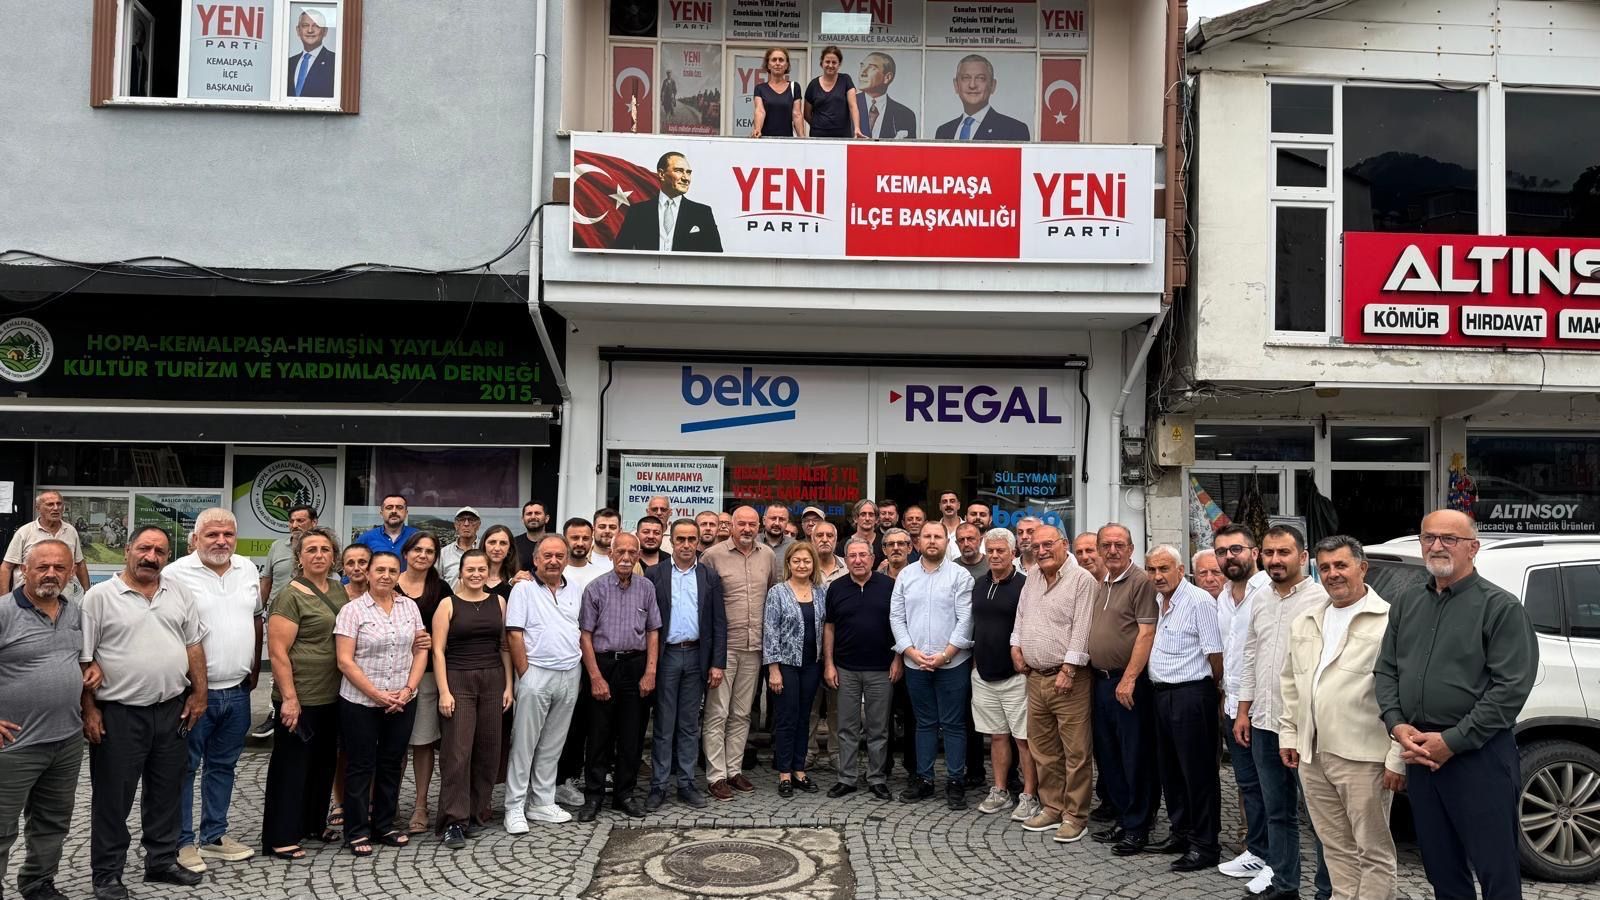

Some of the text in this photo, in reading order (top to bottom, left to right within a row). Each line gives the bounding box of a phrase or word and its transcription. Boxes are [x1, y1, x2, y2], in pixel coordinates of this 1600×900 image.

[765, 9, 779, 17] YENİ
[780, 10, 801, 18] Partisi
[977, 5, 992, 13] YENİ
[764, 19, 778, 28] YENİ
[979, 15, 993, 24] YENİ
[981, 25, 996, 34] YENİ
[779, 31, 800, 39] Partisi
[206, 58, 253, 67] KEMALPAŞA
[222, 69, 238, 79] İLÇE
[206, 83, 253, 93] BAŞKANLIĞI
[876, 174, 992, 199] KEMALPAŞA
[850, 203, 1016, 231] İLÇE BAŞKANLIĞI
[1374, 307, 1439, 329] KÖMÜR
[1466, 313, 1543, 332] HIRDAVAT
[87, 333, 504, 358] HOPA-KEMALPAŞA-HEMŞİN YAYLALARI
[63, 355, 148, 377] KÜLTÜR
[155, 357, 238, 379] TURİZM
[244, 362, 272, 379] VE
[277, 362, 437, 384] YARDIMLAŞMA
[444, 362, 540, 382] DERNEĞİ
[681, 366, 800, 406] beko
[480, 383, 532, 401] 2015
[906, 385, 1062, 424] REGAL
[637, 471, 703, 482] DEV KAMPANYA
[995, 471, 1057, 483] SÜLEYMAN
[630, 483, 701, 493] MOBİLYALARIMIZ
[995, 486, 1057, 496] ALTUNSOY
[629, 495, 651, 503] BEYA
[676, 508, 695, 517] YILI
[1490, 504, 1578, 519] ALTINSOY
[1516, 521, 1523, 531] &
[1525, 521, 1559, 531] Temizlik
[1562, 520, 1595, 531] Ürünleri
